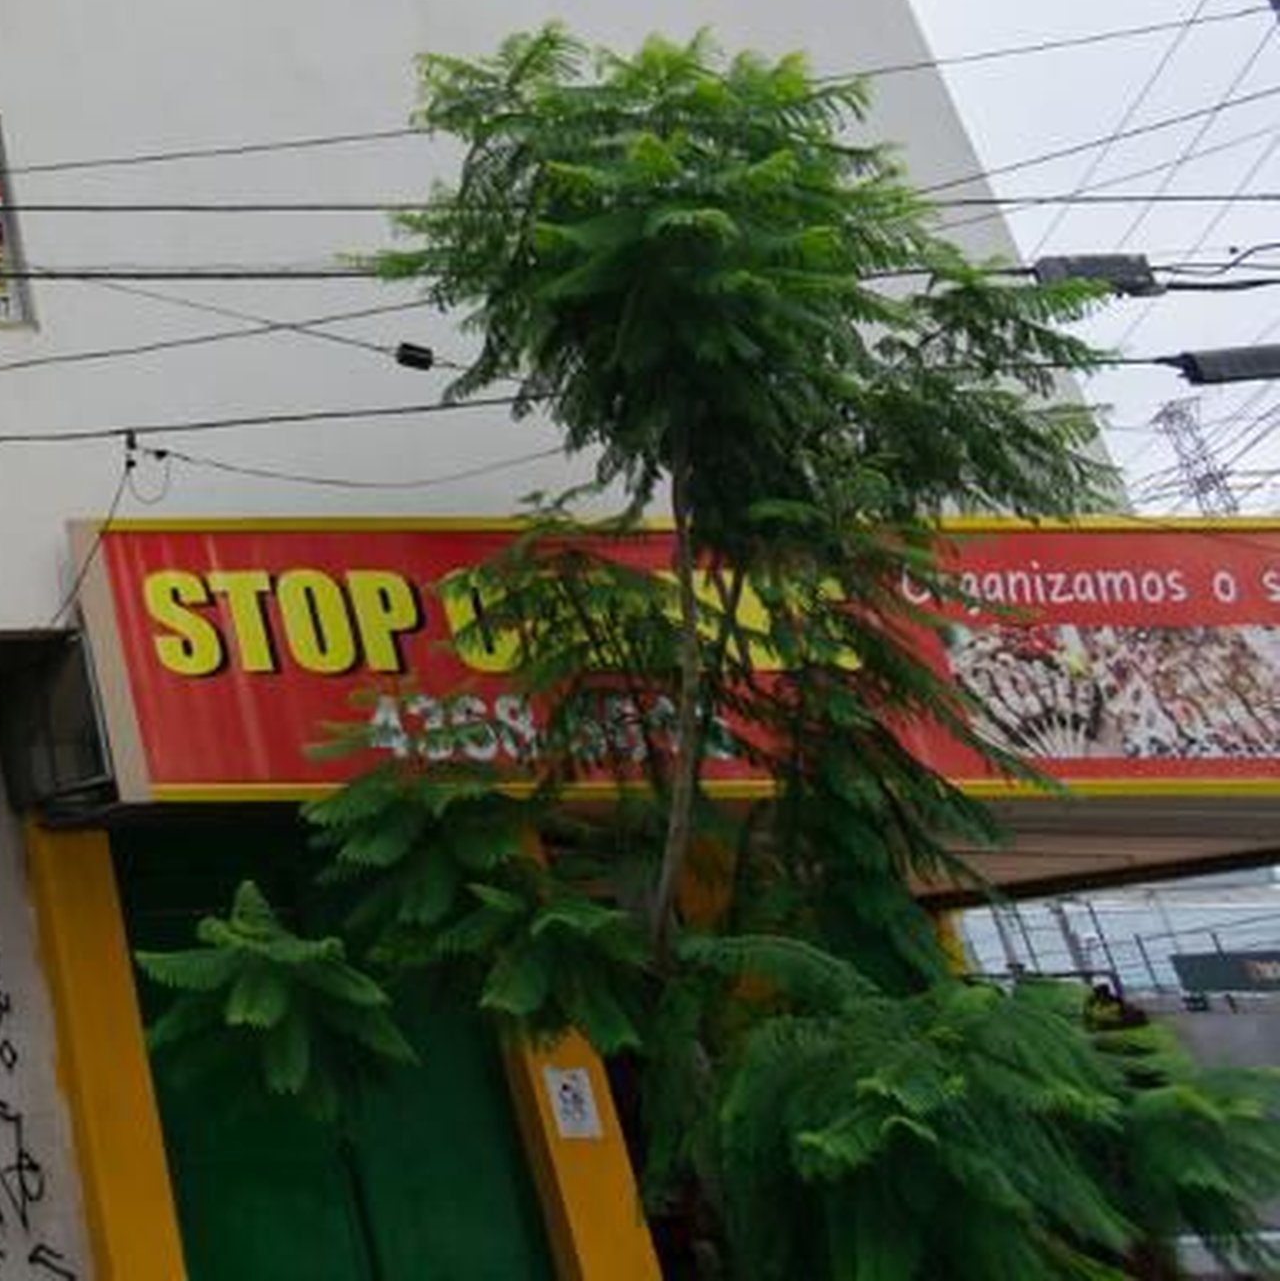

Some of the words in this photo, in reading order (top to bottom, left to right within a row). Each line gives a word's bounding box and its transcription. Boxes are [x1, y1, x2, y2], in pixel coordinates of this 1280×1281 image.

[143, 568, 424, 678] STOP
[901, 561, 1188, 617] Oganizamos
[1212, 571, 1237, 603] o
